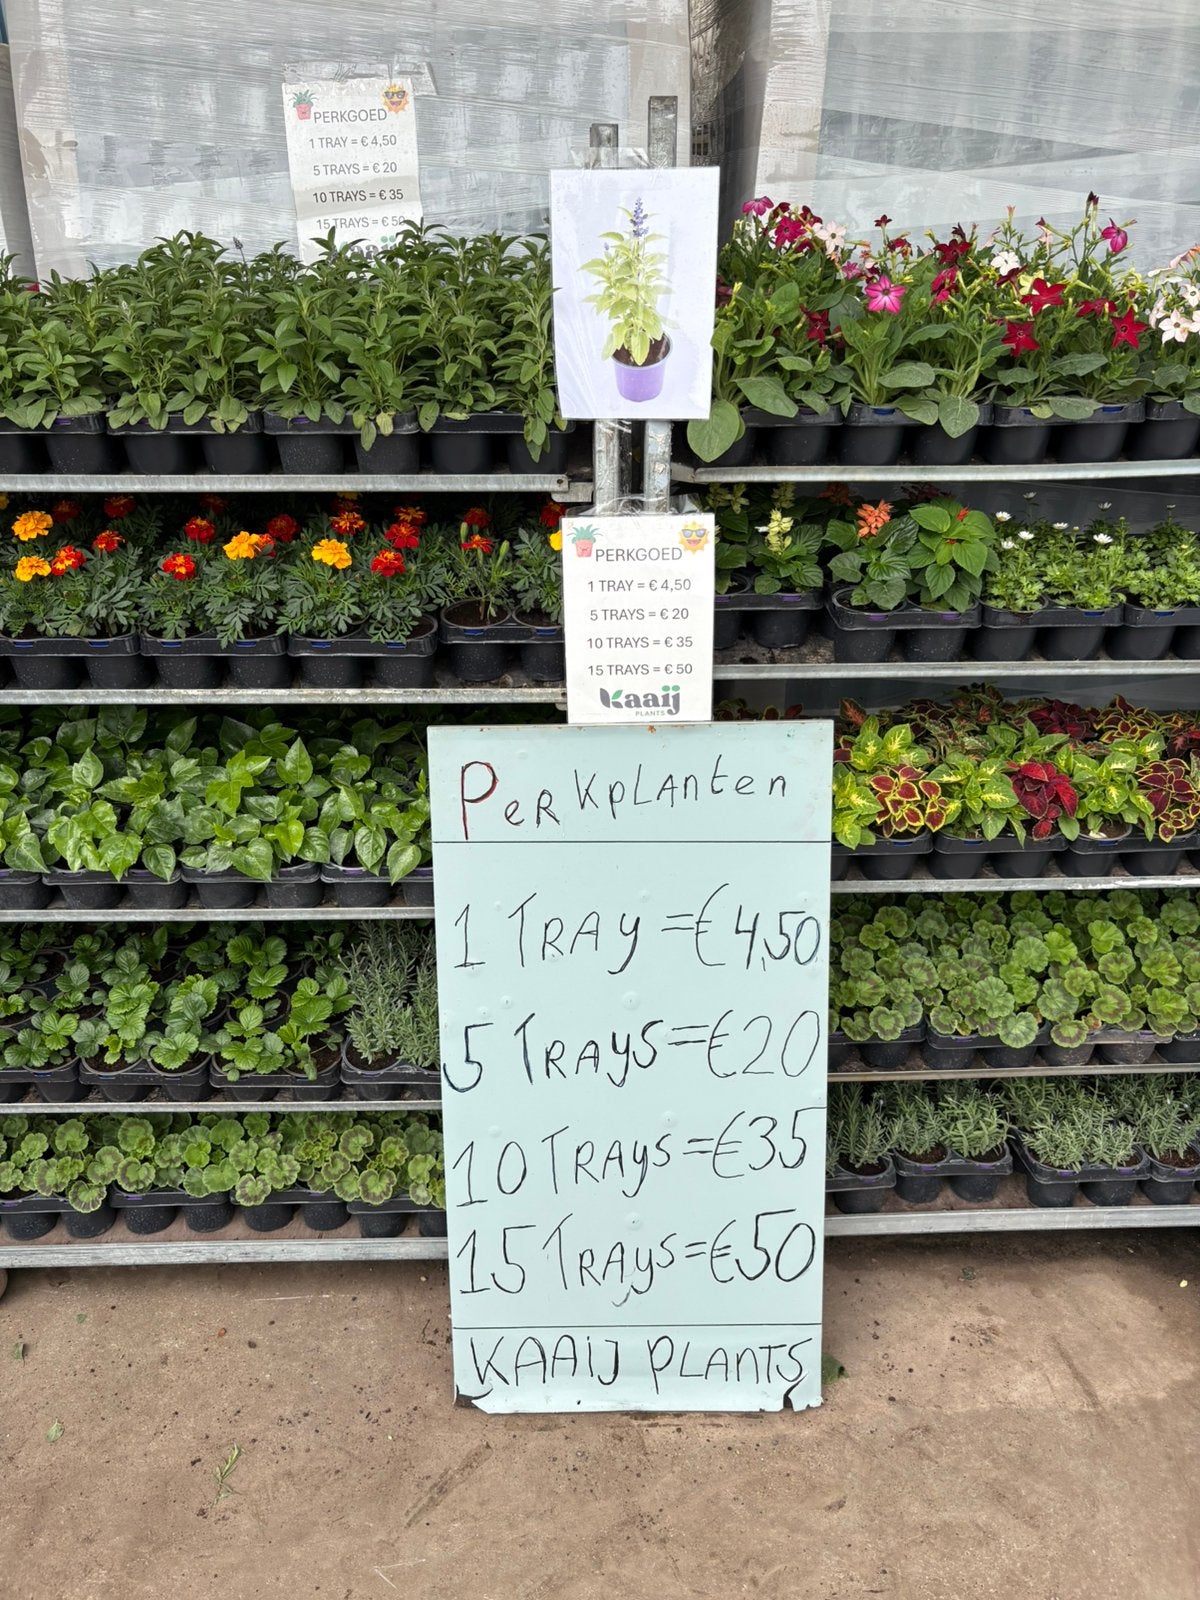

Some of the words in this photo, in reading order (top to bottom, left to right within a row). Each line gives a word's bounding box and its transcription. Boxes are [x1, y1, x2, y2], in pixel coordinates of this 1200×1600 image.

[313, 108, 388, 123] PERKGOED
[309, 138, 314, 149] 1
[318, 136, 347, 148] TRAY
[313, 165, 320, 176] 5
[323, 163, 360, 175] TRAYS
[313, 192, 327, 203] 10
[329, 190, 366, 203] TRAYS
[316, 218, 330, 230] 15
[332, 217, 369, 229] TRAYS
[595, 547, 682, 562] PERKGOED
[588, 581, 594, 592] 1
[598, 580, 634, 591] TRAY
[590, 610, 598, 621] 5
[601, 609, 645, 621] TRAYS
[587, 638, 603, 649] 10
[606, 637, 649, 648] TRAYS
[588, 665, 603, 676] 15
[607, 664, 649, 675] TRAYS
[599, 685, 680, 716] Kaaij
[454, 904, 486, 969] 1
[443, 1022, 494, 1093] 5
[452, 1140, 527, 1208] 10
[456, 1225, 537, 1295] 15
